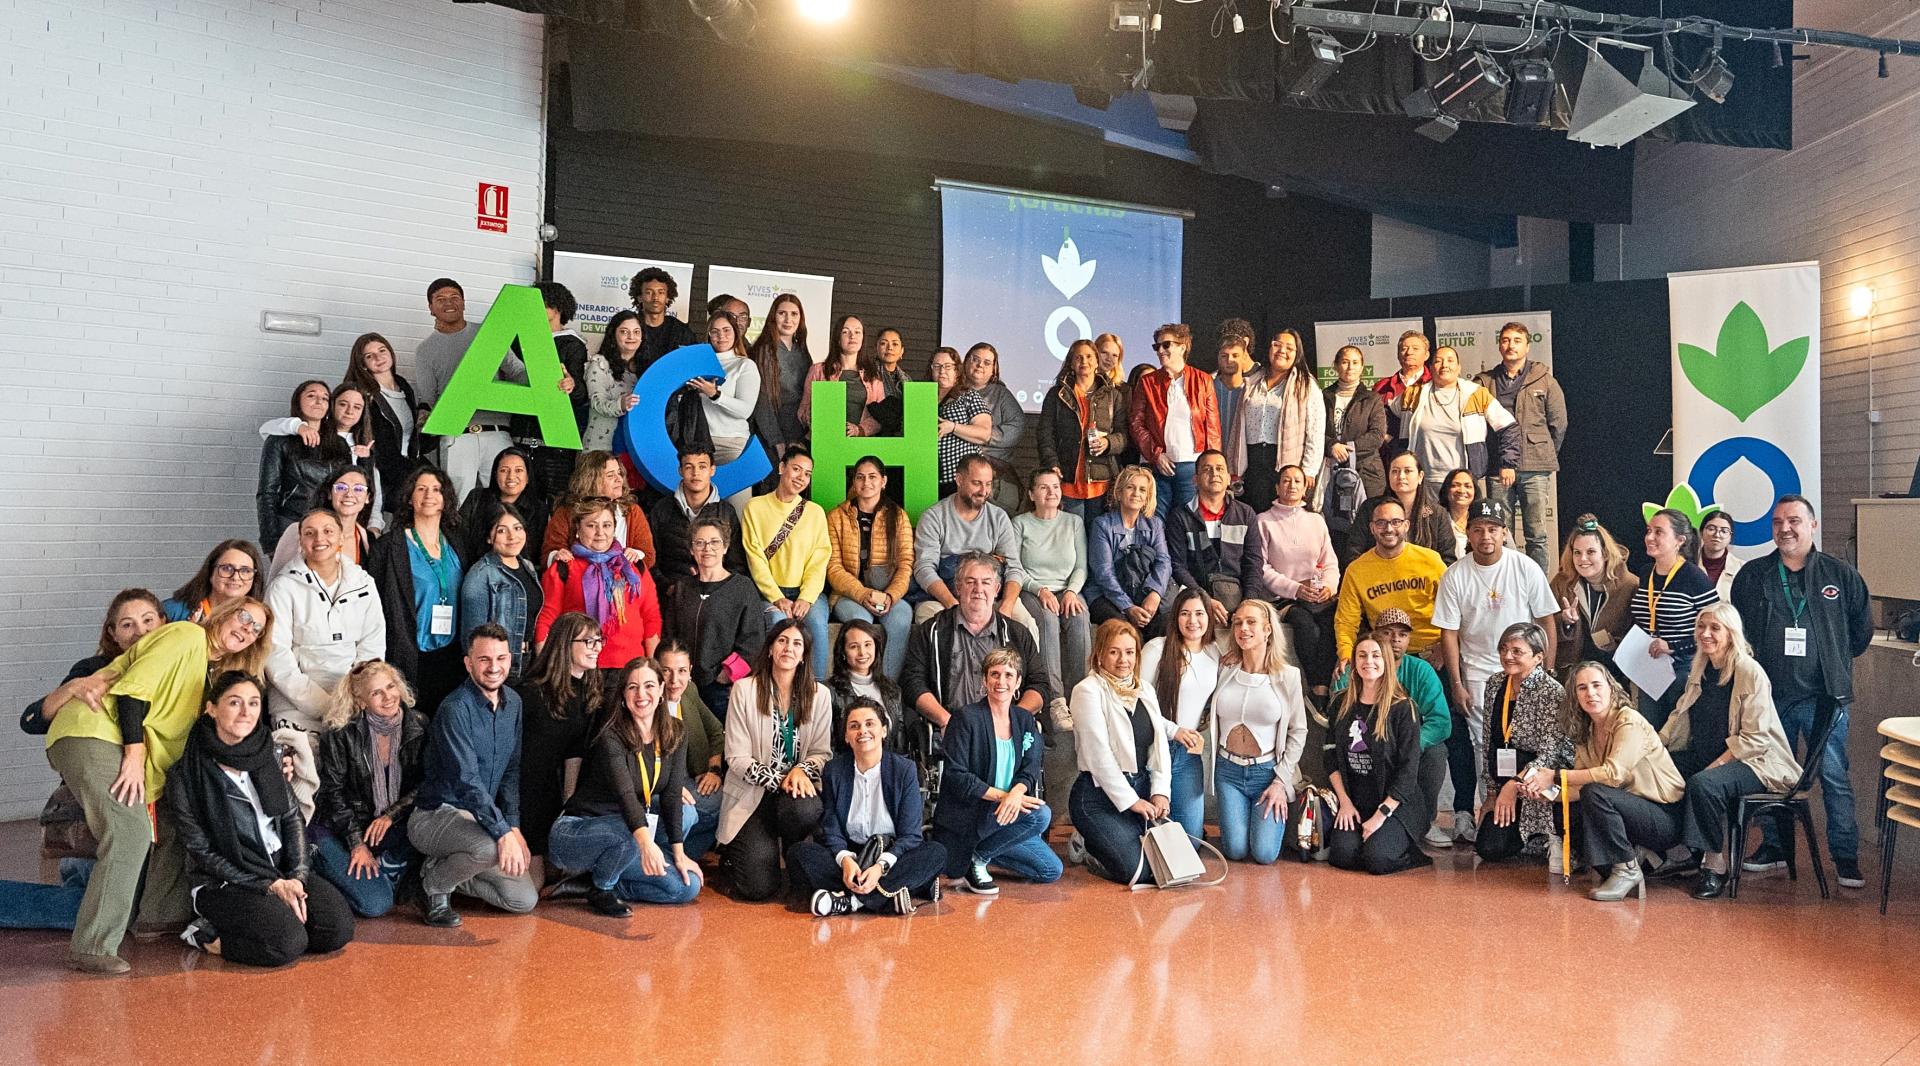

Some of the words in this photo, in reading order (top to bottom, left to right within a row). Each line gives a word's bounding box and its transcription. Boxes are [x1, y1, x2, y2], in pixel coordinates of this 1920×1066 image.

[747, 285, 771, 293] VIVES
[582, 324, 593, 332] DE
[1438, 336, 1475, 347] FUTUR
[1367, 577, 1426, 599] CHEVIGNON
